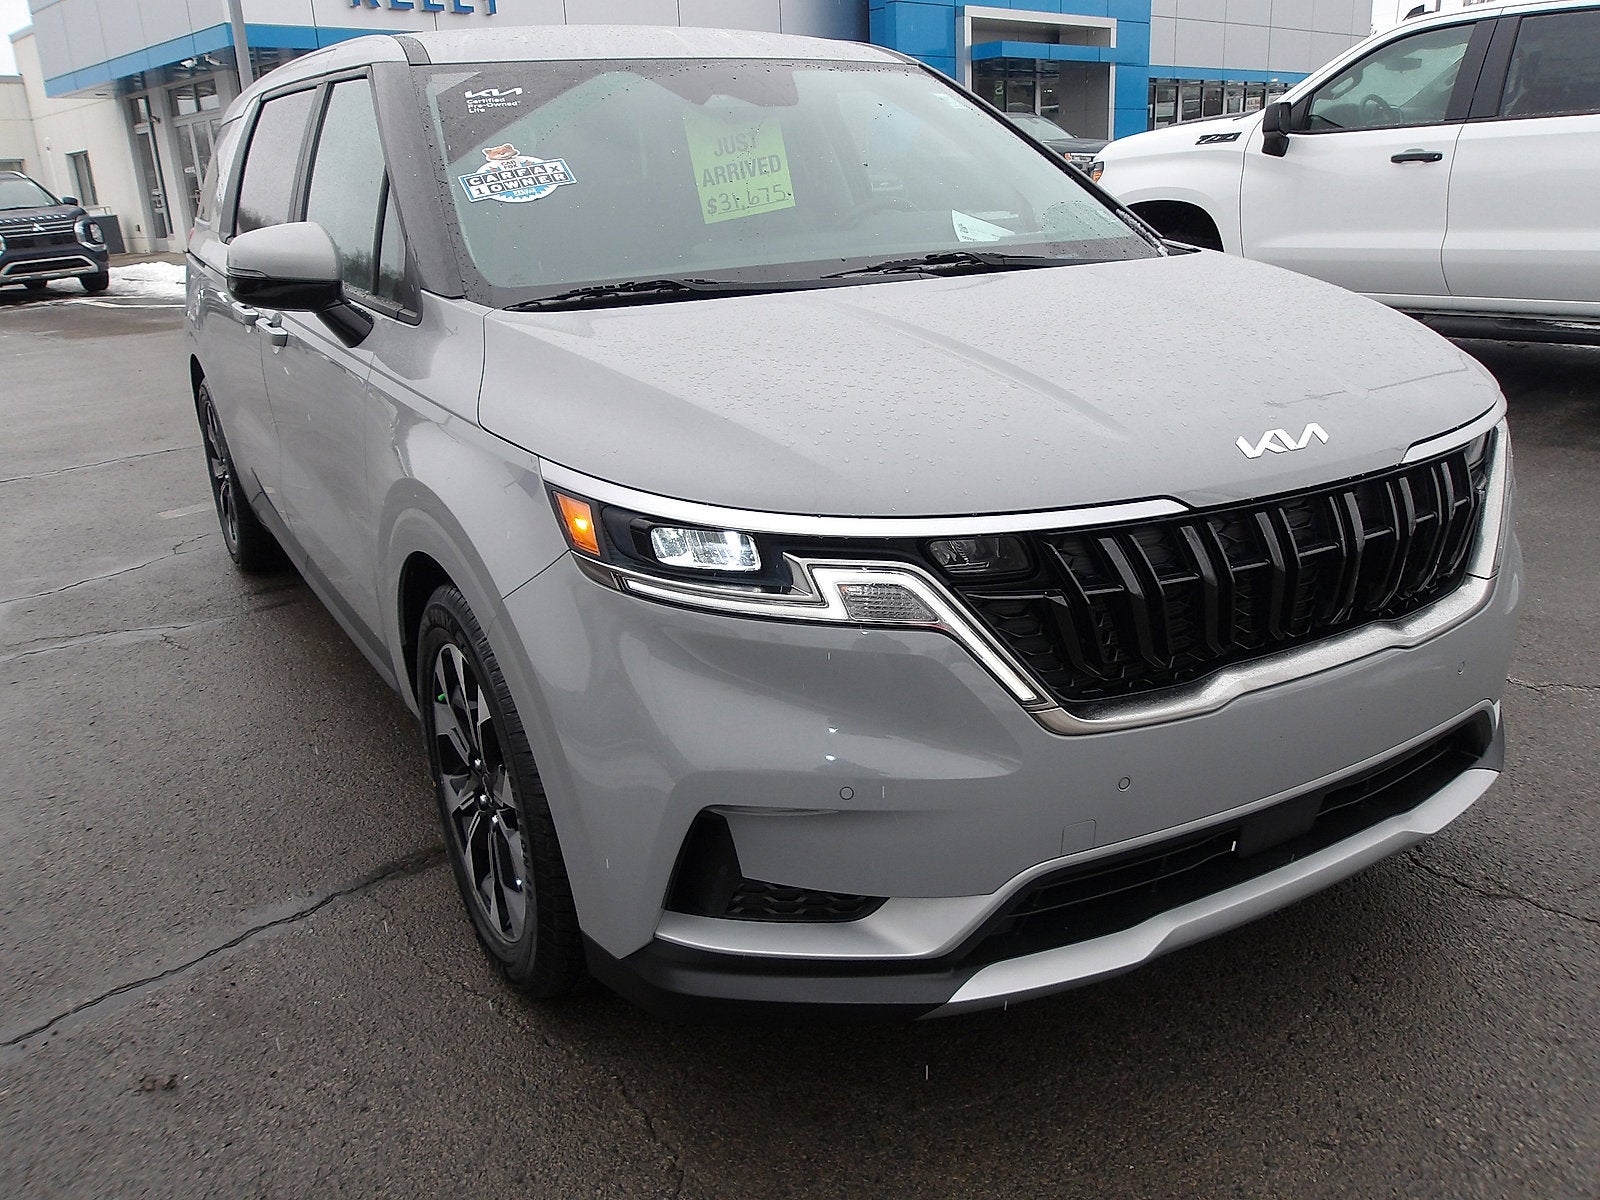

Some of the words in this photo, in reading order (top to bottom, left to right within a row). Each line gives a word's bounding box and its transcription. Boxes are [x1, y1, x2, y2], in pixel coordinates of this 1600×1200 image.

[714, 131, 757, 157] JUST
[467, 164, 561, 187] CARFAX
[702, 154, 782, 188] ARRIVED
